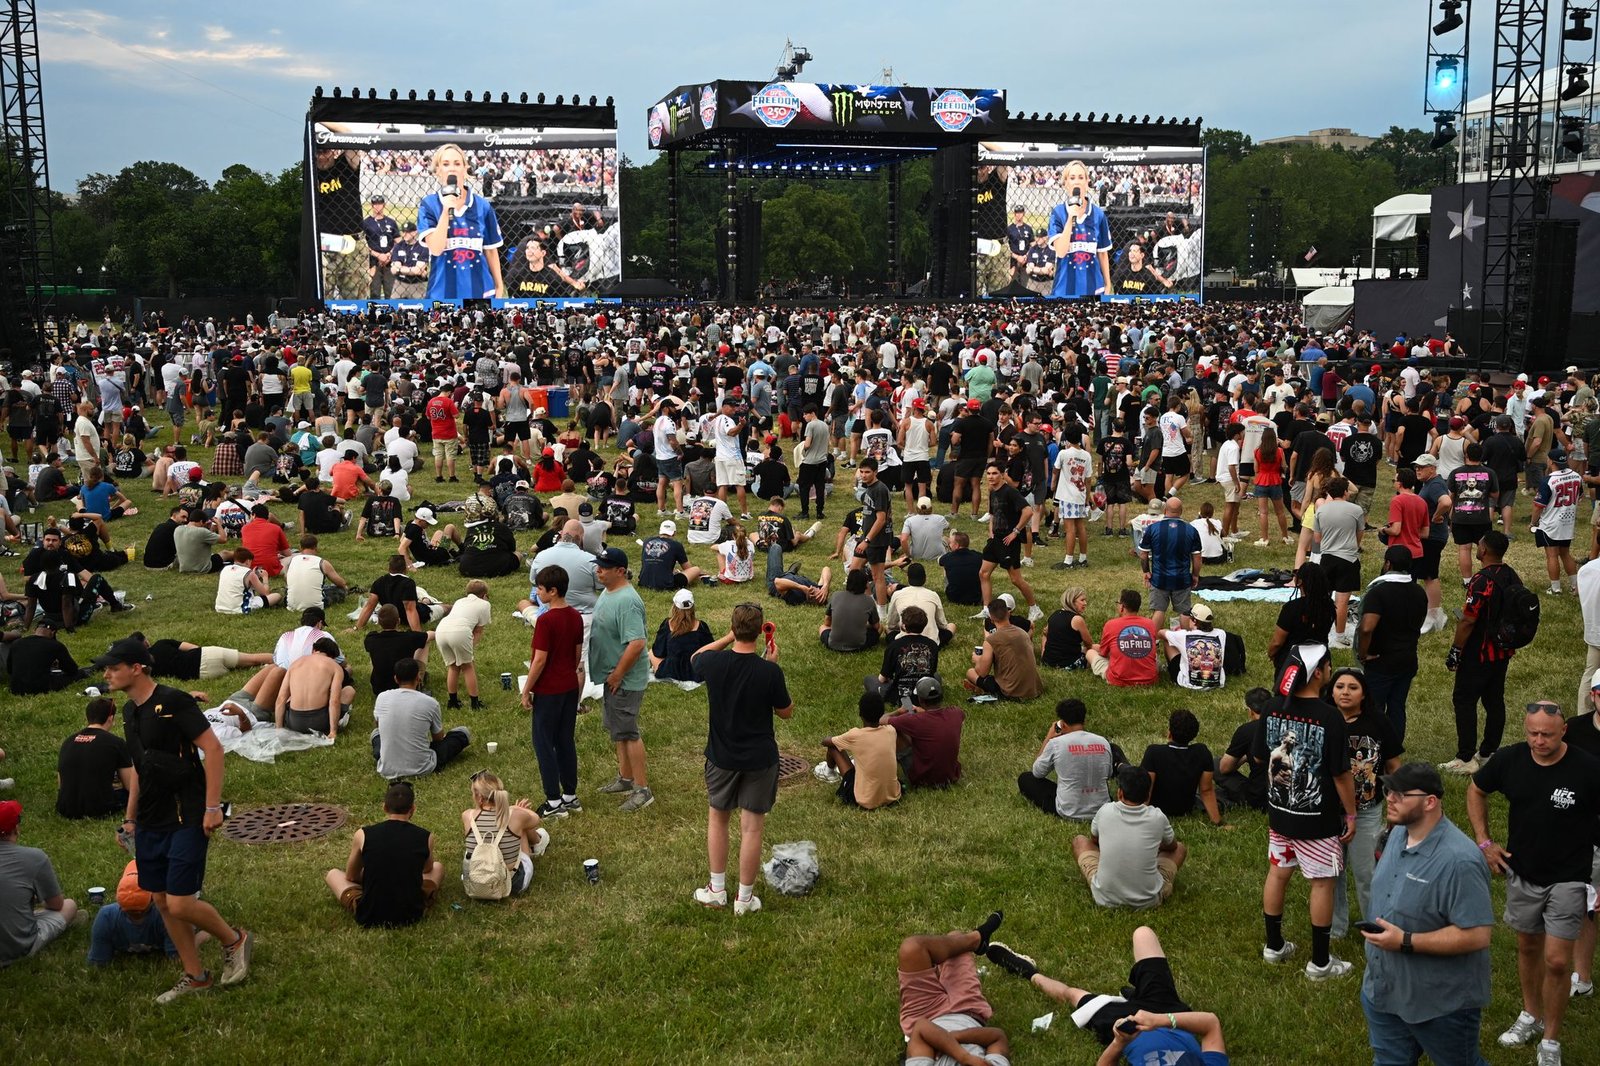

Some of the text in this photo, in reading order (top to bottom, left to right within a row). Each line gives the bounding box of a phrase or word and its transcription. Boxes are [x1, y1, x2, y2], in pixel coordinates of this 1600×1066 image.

[752, 96, 800, 109] FREEDOM
[855, 99, 902, 109] MONSTER
[932, 102, 975, 114] FREEDOM
[767, 107, 787, 119] 250
[945, 112, 963, 123] 250
[316, 131, 381, 145] Paramount+
[484, 133, 542, 147] Paramount+
[978, 150, 1025, 162] Paramount+
[1102, 151, 1147, 163] Paramount+
[453, 249, 476, 264] 250
[520, 281, 549, 294] ARMY
[1122, 280, 1146, 292] ARMY
[430, 407, 447, 420] 34
[1554, 480, 1580, 508] 250
[1068, 743, 1106, 753] WILSON
[1553, 788, 1576, 799] UFC
